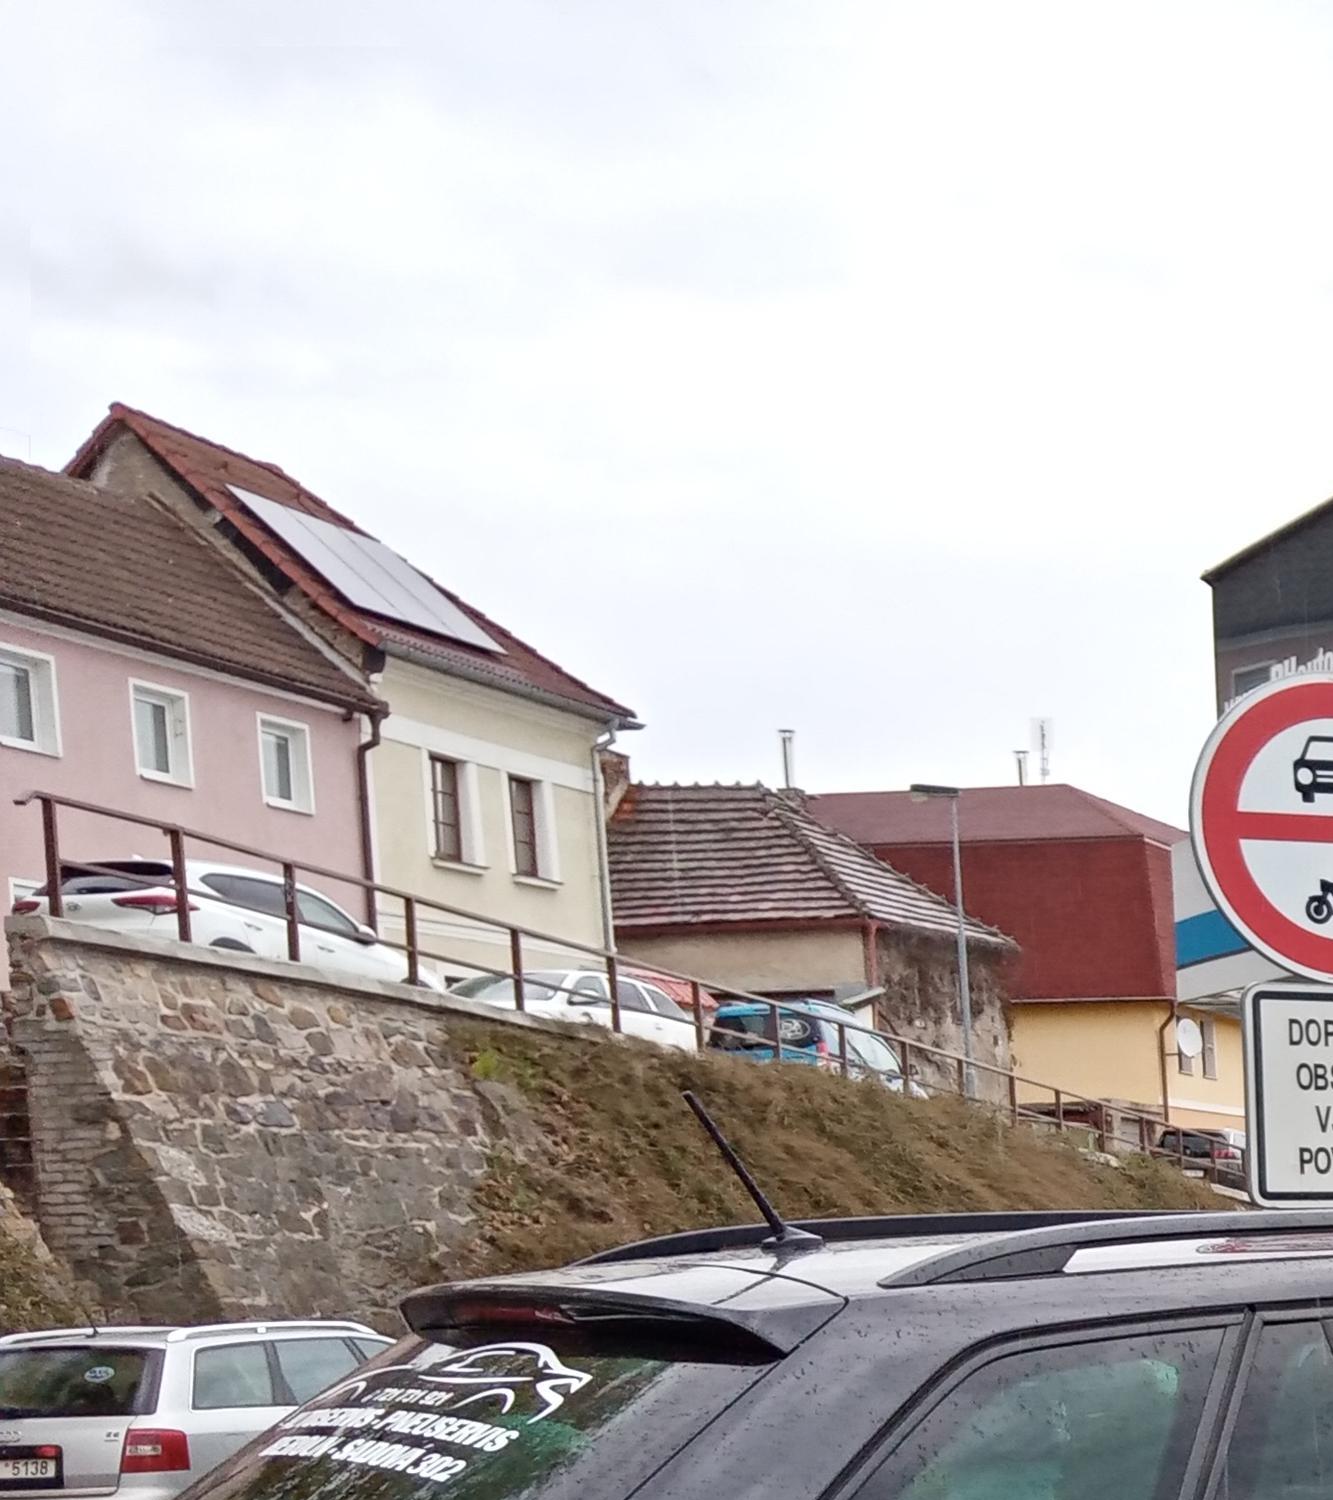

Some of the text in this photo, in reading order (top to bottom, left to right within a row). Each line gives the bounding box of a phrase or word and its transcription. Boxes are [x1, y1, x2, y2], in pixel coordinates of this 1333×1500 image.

[373, 1410, 519, 1451] PNEUSERVIS
[12, 1461, 48, 1476] 5138
[406, 1453, 467, 1482] 302
